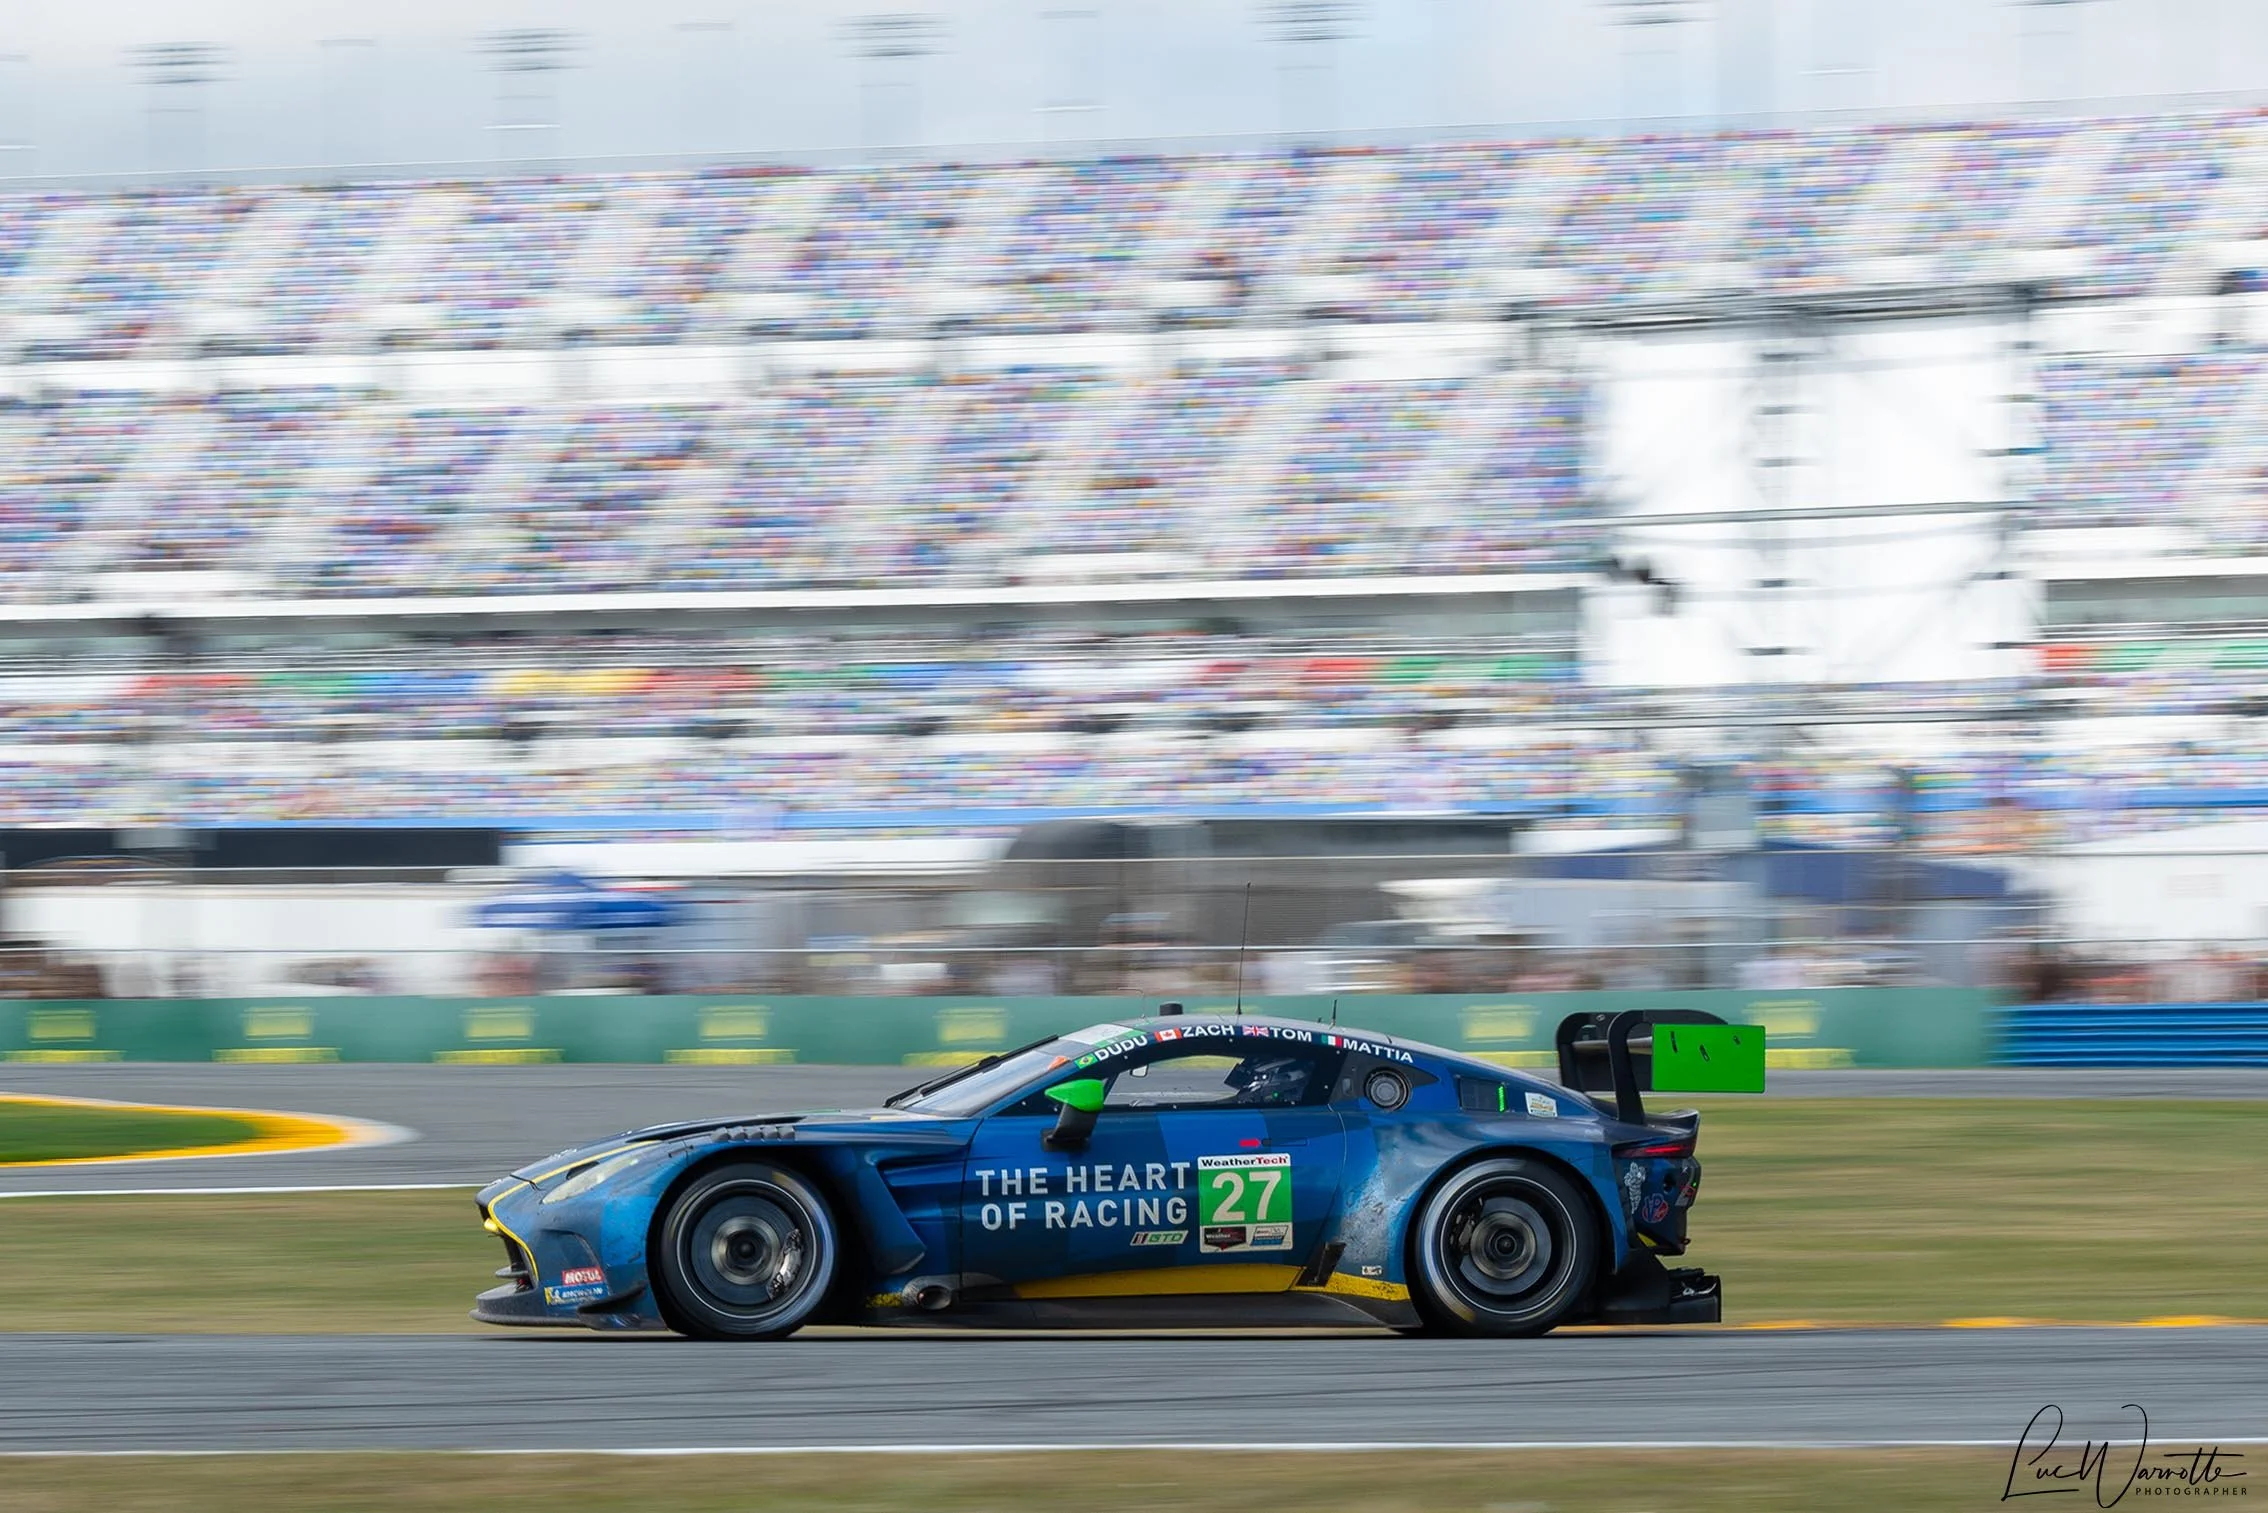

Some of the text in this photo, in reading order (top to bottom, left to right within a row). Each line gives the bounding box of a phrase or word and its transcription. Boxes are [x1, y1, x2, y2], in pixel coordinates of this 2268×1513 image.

[1094, 1025, 1413, 1062] DUDU ZACH TOM MATTIA
[1201, 1156, 1287, 1167] WeatherTech
[975, 1162, 1191, 1196] THE HEART
[1212, 1171, 1282, 1222] 27
[981, 1197, 1188, 1231] OF RACING
[1148, 1232, 1183, 1243] GTD
